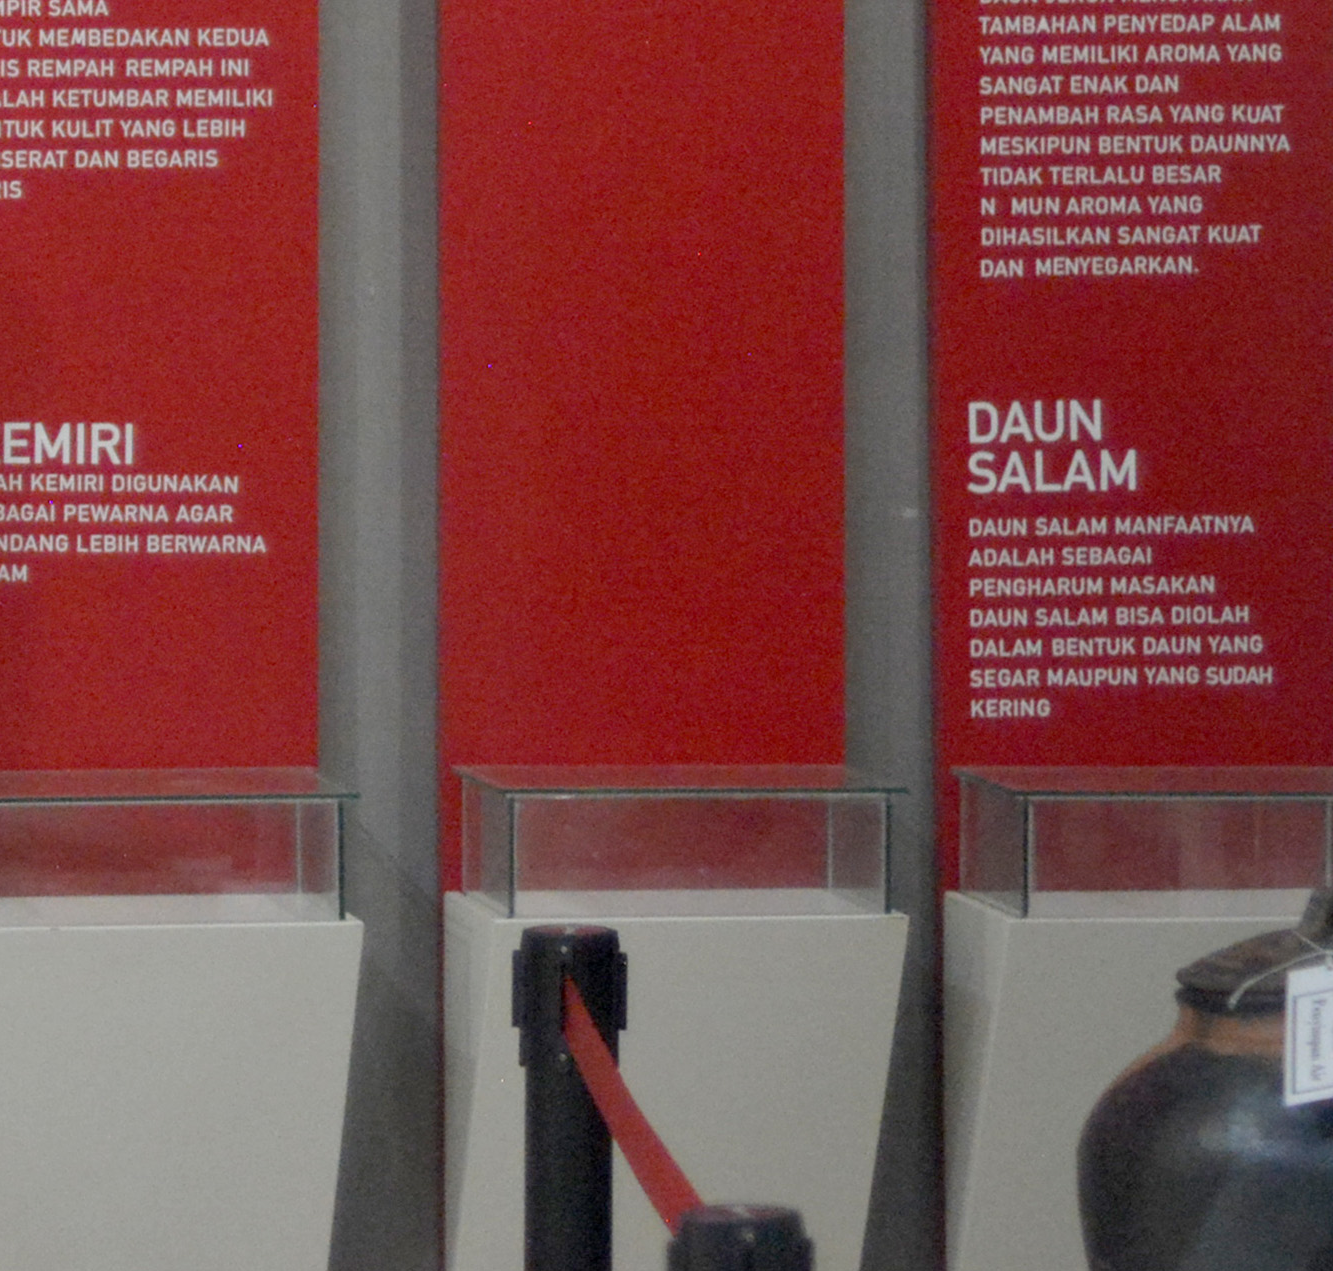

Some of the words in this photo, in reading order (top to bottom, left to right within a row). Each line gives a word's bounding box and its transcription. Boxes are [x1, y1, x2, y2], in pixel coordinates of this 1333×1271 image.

[979, 75, 1064, 96] SANGAT
[1070, 75, 1128, 94] ENAK
[1135, 74, 1179, 94] DAN
[52, 119, 114, 138] KULIT
[120, 119, 176, 138] YANG
[183, 118, 247, 138] LEBIH
[979, 166, 1043, 186] TIDAK
[1049, 165, 1145, 185] TERLALU
[1152, 164, 1222, 184] BESAR
[967, 398, 1103, 445] DAUN
[967, 448, 1138, 495] SALAM
[30, 473, 104, 492] KEMIRI
[112, 474, 240, 495] DIGUNAKAN
[968, 517, 1028, 538] DAUN
[1035, 516, 1108, 536] SALAM
[1114, 514, 1255, 535] MANFAATNYA
[76, 534, 139, 554] LEBIH
[146, 534, 268, 554] BERWARNA
[969, 577, 1103, 597] PENGHARUM
[1110, 575, 1216, 595] MASAKAN
[969, 668, 1040, 688] SEGAR
[1047, 667, 1138, 687] MAUPUN
[1144, 665, 1200, 685] YANG
[1205, 665, 1274, 686] SUDAH
[970, 698, 1052, 718] KERING
